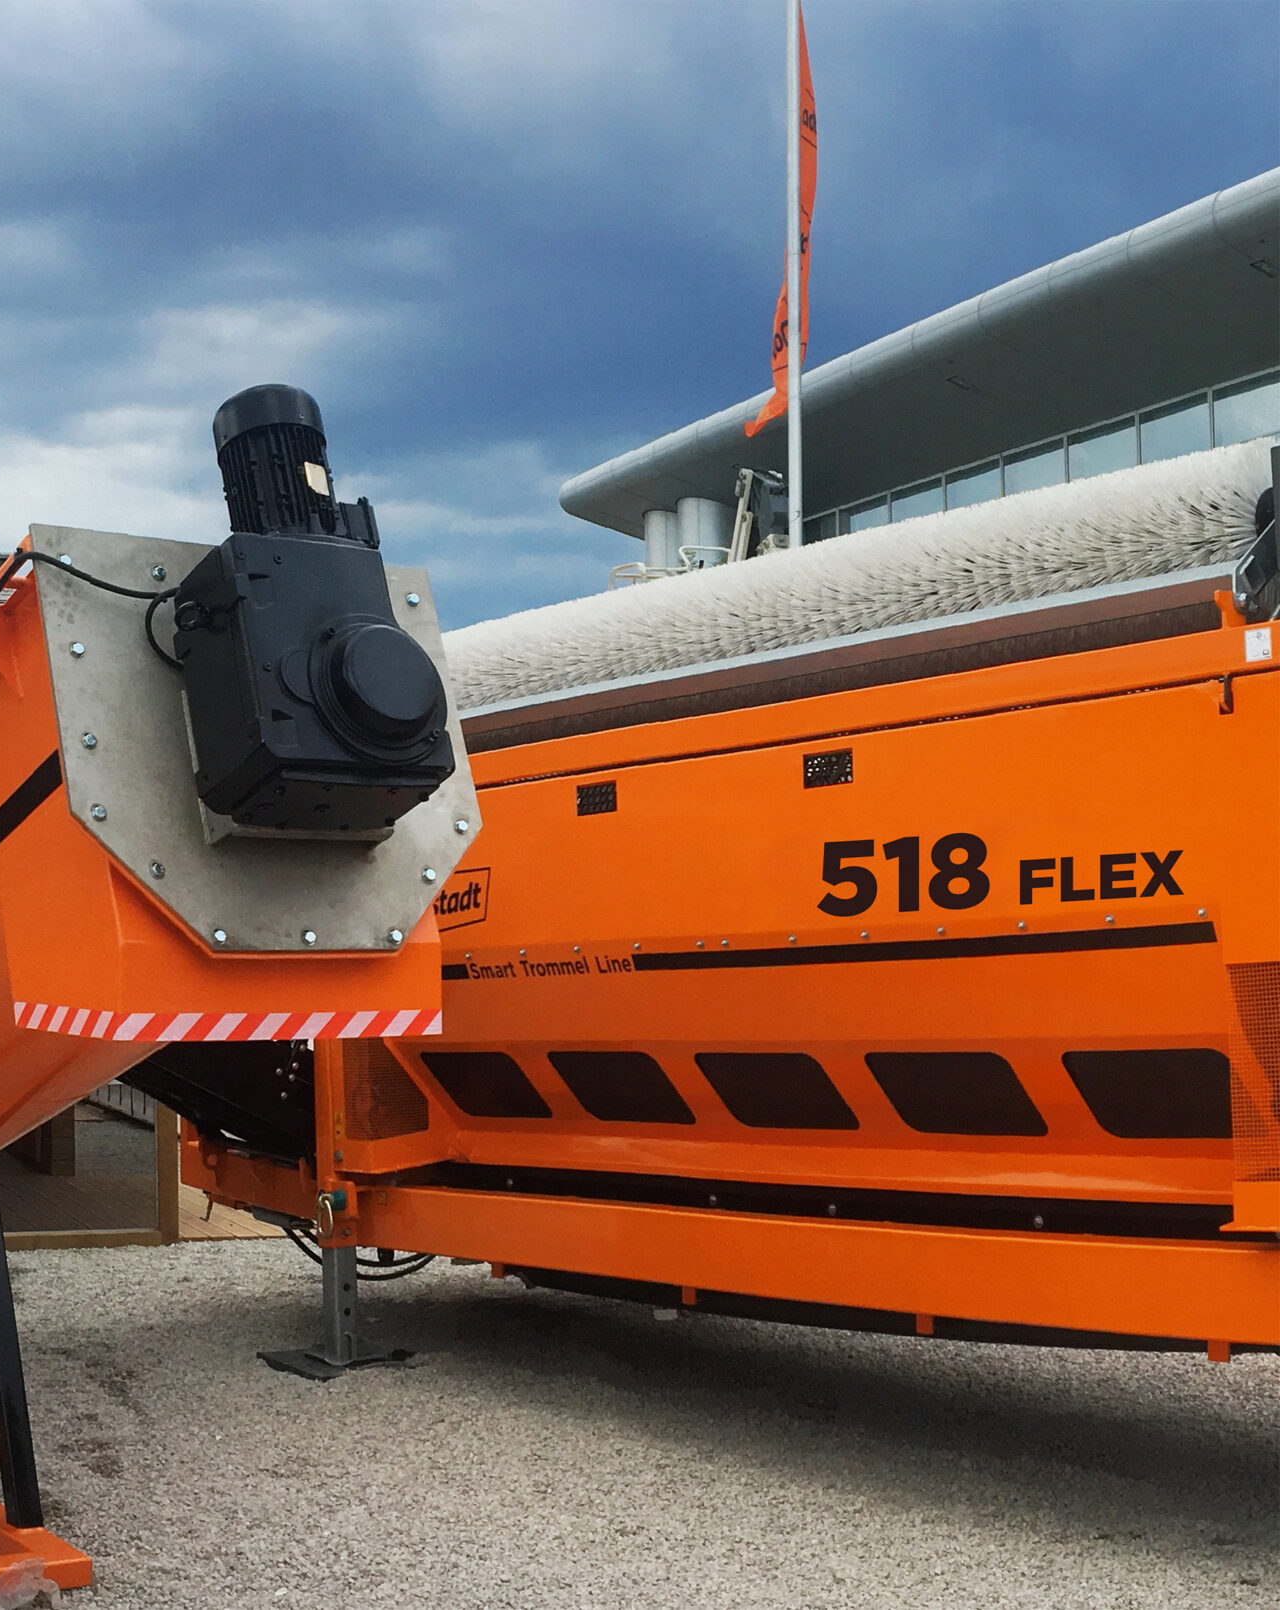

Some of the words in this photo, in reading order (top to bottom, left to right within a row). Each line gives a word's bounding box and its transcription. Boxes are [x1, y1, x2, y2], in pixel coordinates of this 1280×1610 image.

[817, 832, 990, 917] 518
[1020, 850, 1184, 905] FLEX
[470, 962, 516, 980] Smart
[520, 956, 590, 977] Trommel
[595, 955, 633, 974] Line
